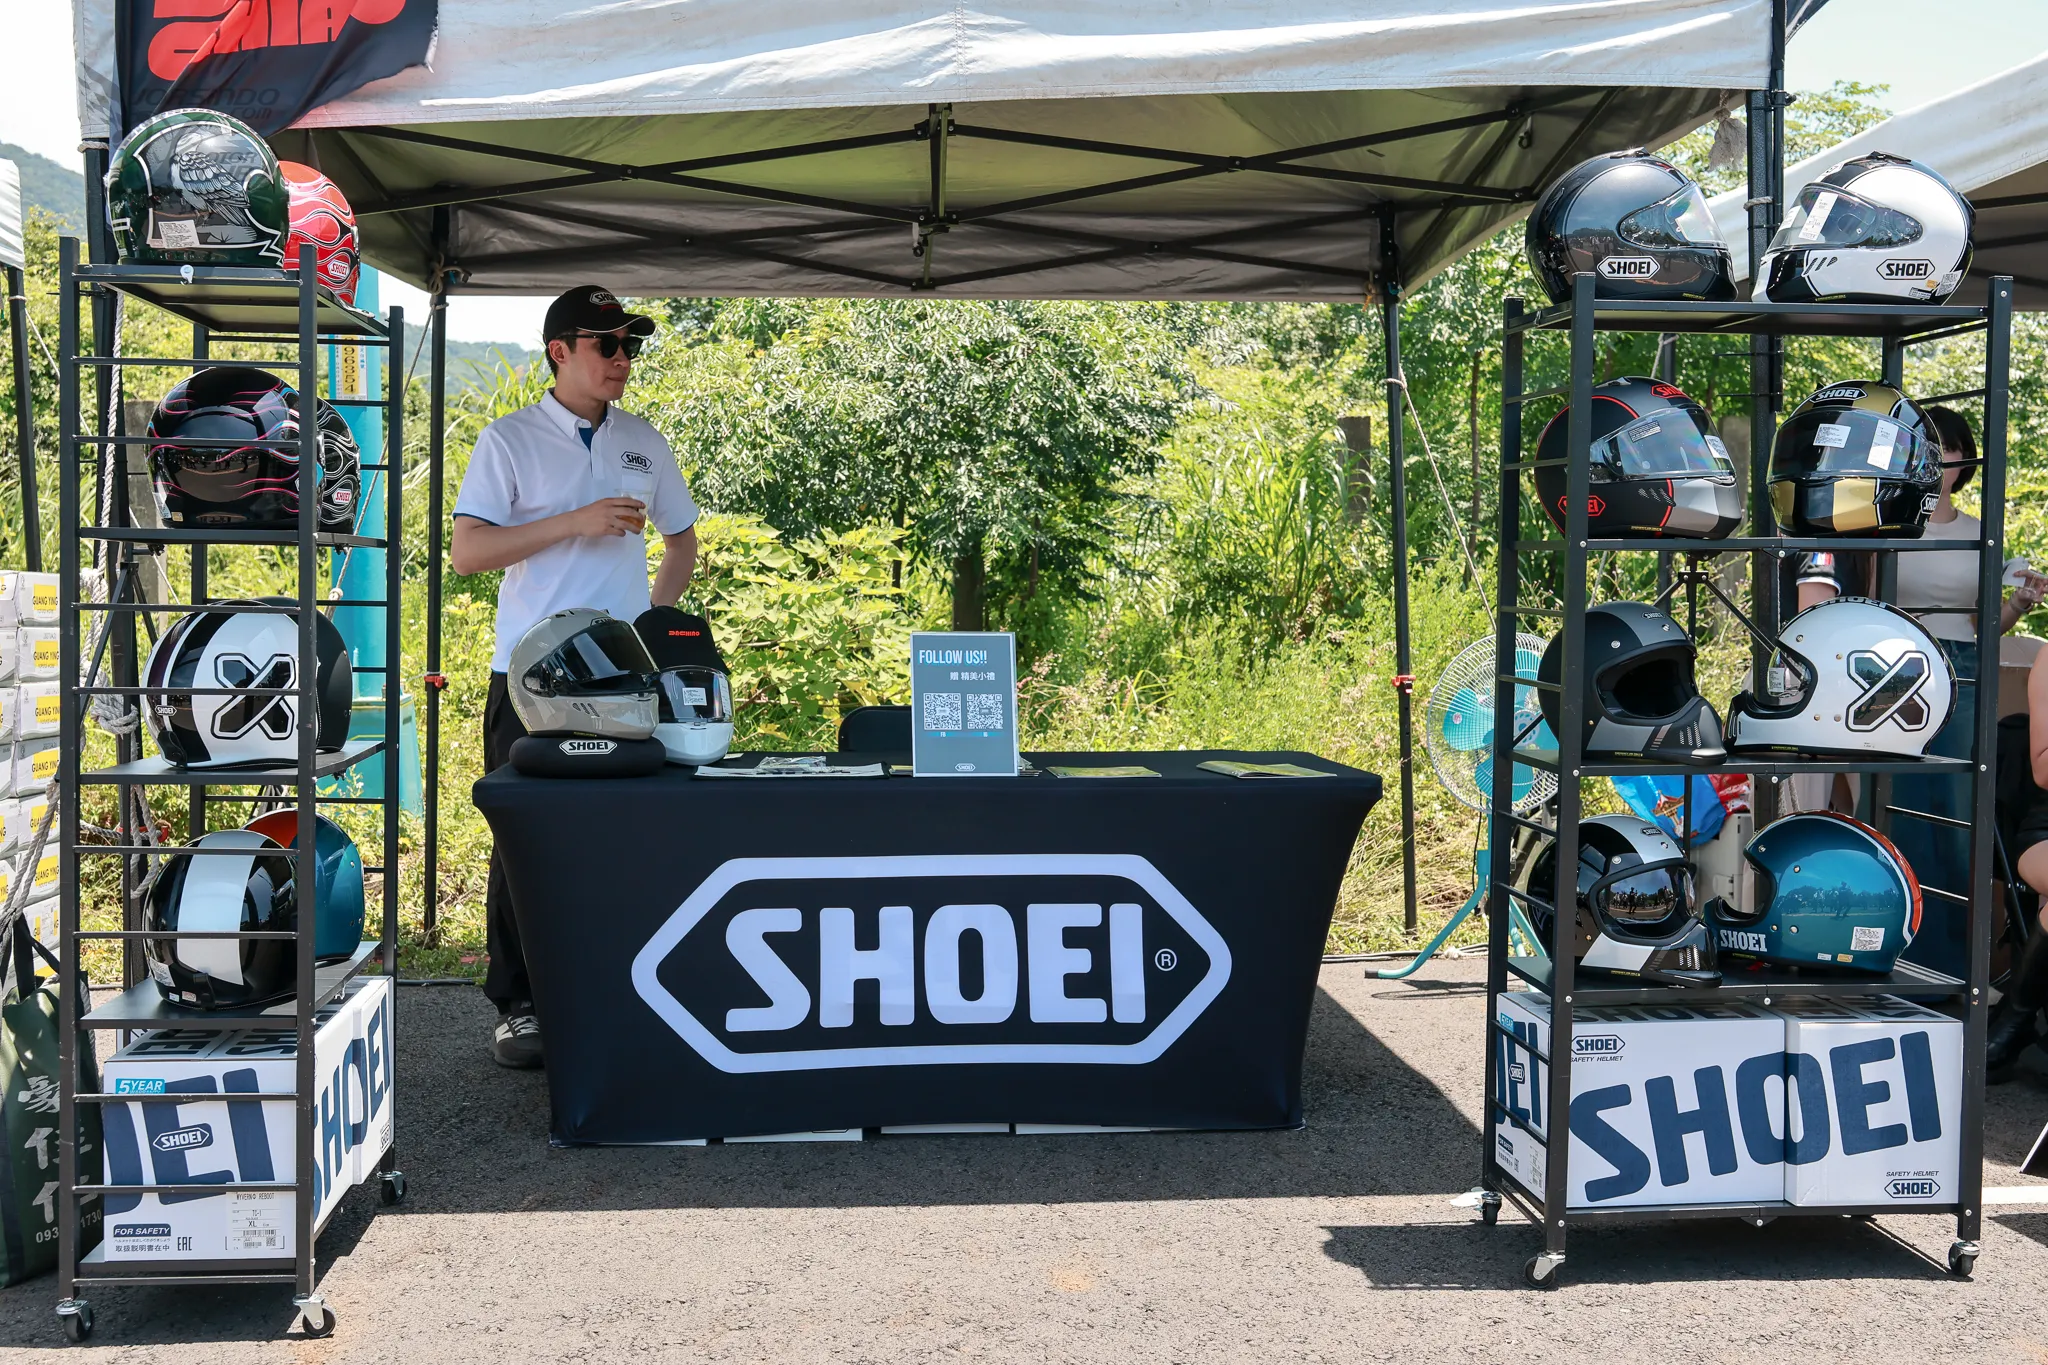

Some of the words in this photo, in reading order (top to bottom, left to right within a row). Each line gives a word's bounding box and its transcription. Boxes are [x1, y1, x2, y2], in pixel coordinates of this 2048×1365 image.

[1608, 261, 1651, 274] SHOEI
[1886, 263, 1928, 276] SHOEI
[595, 293, 615, 302] SHO
[1816, 389, 1859, 400] SHOEI
[919, 650, 962, 664] FOLLOW
[965, 650, 987, 664] US!!
[52, 706, 61, 715] YIN
[568, 742, 609, 751] SHOEI
[1720, 929, 1768, 953] SHOEI
[725, 903, 1147, 1032] SHOEI
[1576, 1039, 1617, 1051] SHOEI
[161, 1131, 202, 1147] SHOEI
[1893, 1182, 1933, 1195] SHOEI
